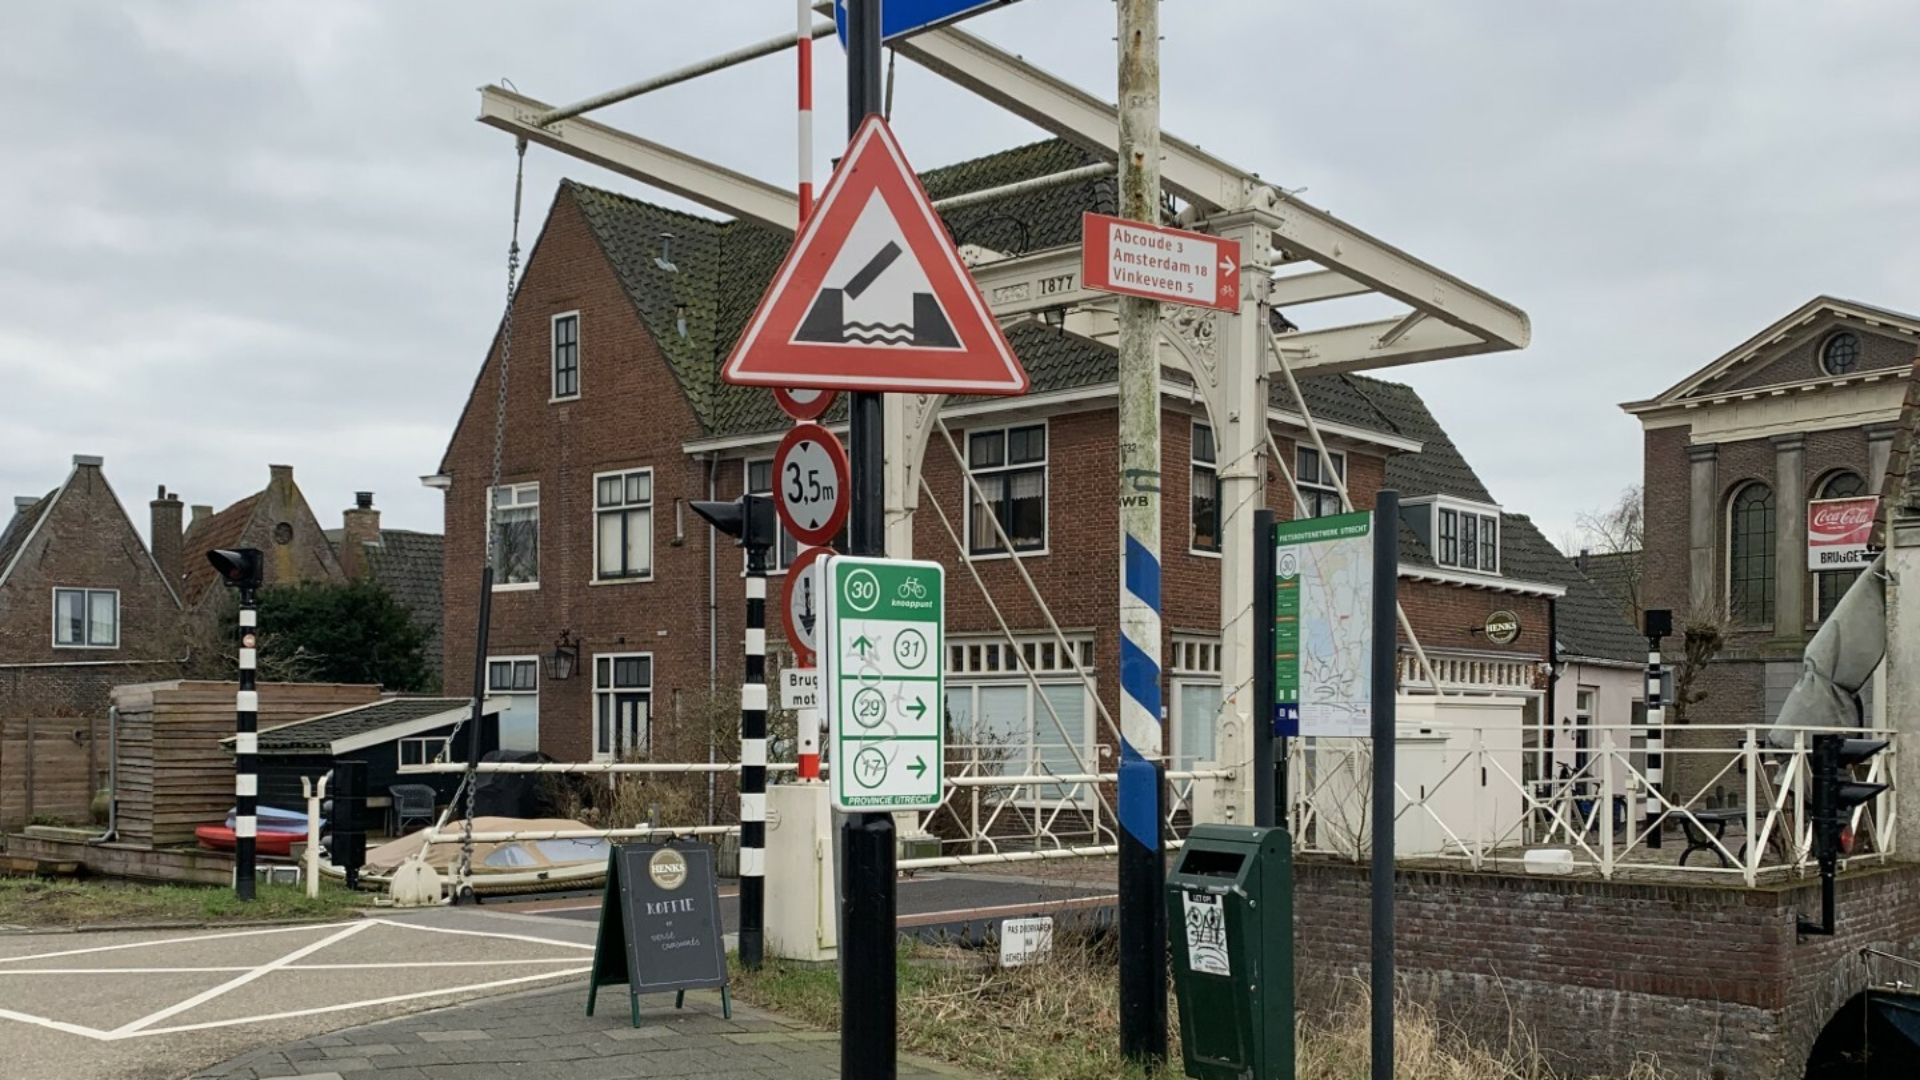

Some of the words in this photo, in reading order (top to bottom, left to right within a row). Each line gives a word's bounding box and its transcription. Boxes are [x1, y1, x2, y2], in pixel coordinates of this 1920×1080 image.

[1114, 228, 1172, 251] Abcoude
[1176, 242, 1184, 254] 3
[1113, 248, 1191, 274] Amsterdam
[1194, 265, 1208, 277] 18
[1041, 276, 1073, 294] 1877
[1113, 267, 1183, 291] Vinkeveen
[1187, 282, 1194, 293] 5
[1340, 524, 1368, 535] UTRECHT
[1282, 560, 1294, 572] 30
[851, 581, 874, 599] 30
[891, 599, 933, 609] knooppunt
[1487, 621, 1517, 632] HENKS
[900, 640, 920, 658] 31
[859, 698, 880, 717] 29
[862, 759, 881, 777] 17
[848, 796, 893, 806] PROVINCIE
[895, 794, 933, 804] UTRECHT
[651, 863, 685, 874] HENKS
[646, 898, 695, 915] KOFFIE
